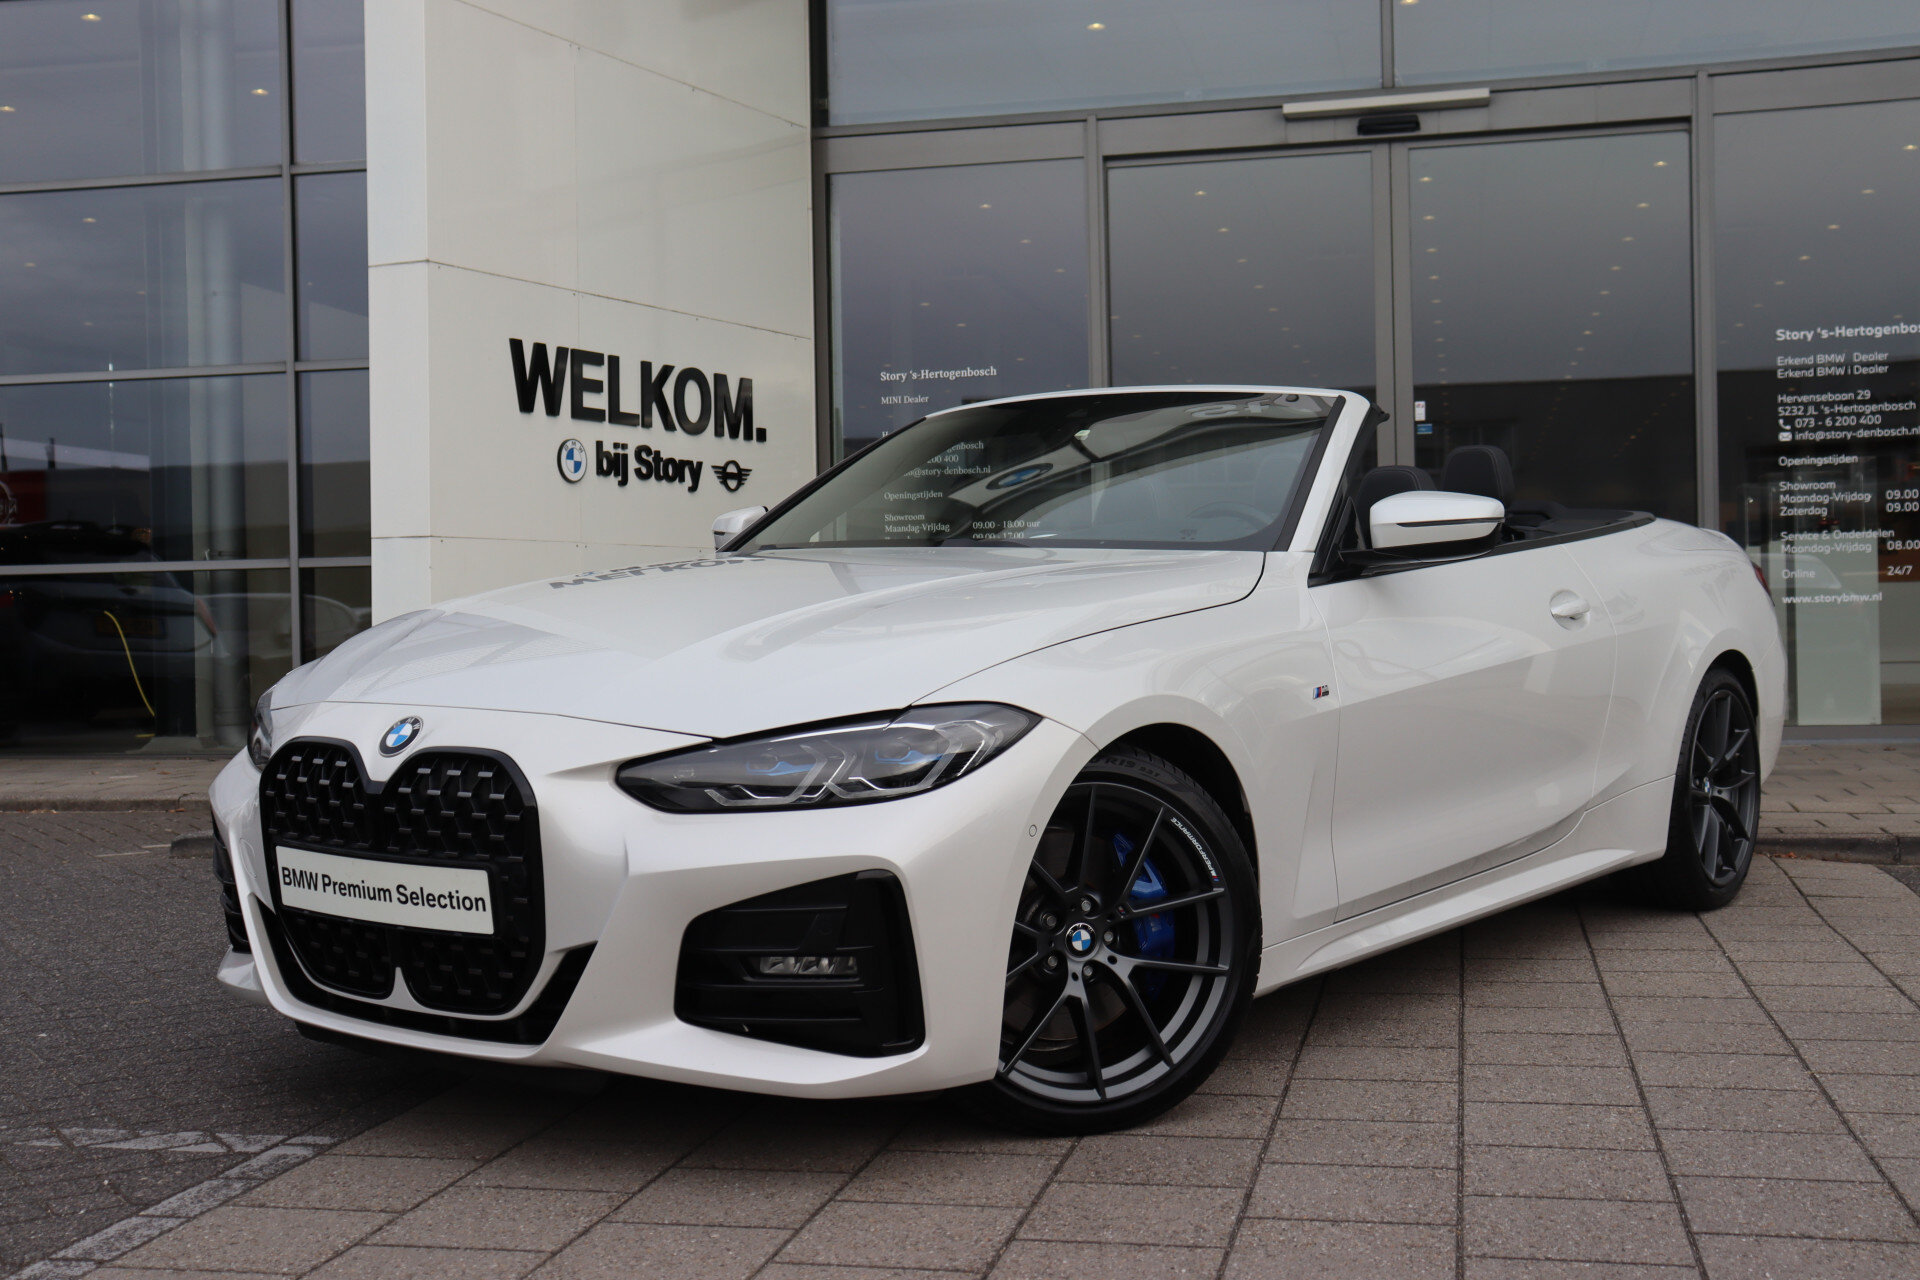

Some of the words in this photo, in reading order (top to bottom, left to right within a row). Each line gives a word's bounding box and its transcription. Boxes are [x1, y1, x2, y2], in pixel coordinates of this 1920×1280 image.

[1775, 328, 1814, 341] Story
[1776, 356, 1814, 367] Erkend
[1816, 353, 1846, 364] BMW
[1852, 351, 1889, 362] Dealer
[880, 371, 907, 383] Story
[909, 365, 997, 380] 's-Hertogenbosch
[1776, 368, 1815, 379] Erkend
[1816, 366, 1846, 377] BMW
[1852, 364, 1889, 375] Dealer
[508, 337, 767, 443] WELKOM.
[1777, 392, 1855, 404] Hervensebaan
[1856, 390, 1872, 400] 29
[880, 396, 902, 405] MINI
[903, 394, 929, 404] Dealer
[1778, 406, 1805, 417] 5232
[1807, 405, 1819, 415] JL
[1820, 400, 1917, 415] 's-Hertogenbosch
[1794, 418, 1815, 428] 073
[1825, 416, 1833, 427] 6
[1835, 415, 1857, 426] 200
[1859, 414, 1882, 425] 400
[1794, 425, 1920, 441] info@story-denbosch.nl
[943, 454, 959, 463] 400
[1778, 454, 1859, 467] Openingstijden
[594, 440, 629, 487] bij
[633, 444, 704, 493] Story
[1778, 480, 1837, 491] Showroom
[883, 490, 943, 502] Openingstijden
[1779, 492, 1872, 504] Maandag-Vrijdag
[1885, 489, 1920, 500] 09.00
[1780, 505, 1828, 518] Zaterdag
[1885, 502, 1920, 513] 09.00
[884, 514, 925, 522] Showroom
[884, 522, 950, 534] Maandag-Vrijdag
[972, 520, 996, 529] 09.00
[1026, 520, 1041, 528] uur
[1780, 531, 1819, 542] Service
[1821, 530, 1831, 539] &
[1833, 528, 1895, 540] Onderdelen
[1781, 542, 1872, 554] Maandag-Vrijdag
[1886, 540, 1920, 551] 08.00
[1782, 568, 1816, 579] Online
[1887, 565, 1913, 576] 24/7
[1782, 592, 1883, 604] www.storybmw.nl
[282, 866, 319, 892] BMW
[322, 875, 393, 903] Premium
[396, 884, 487, 912] Selection
